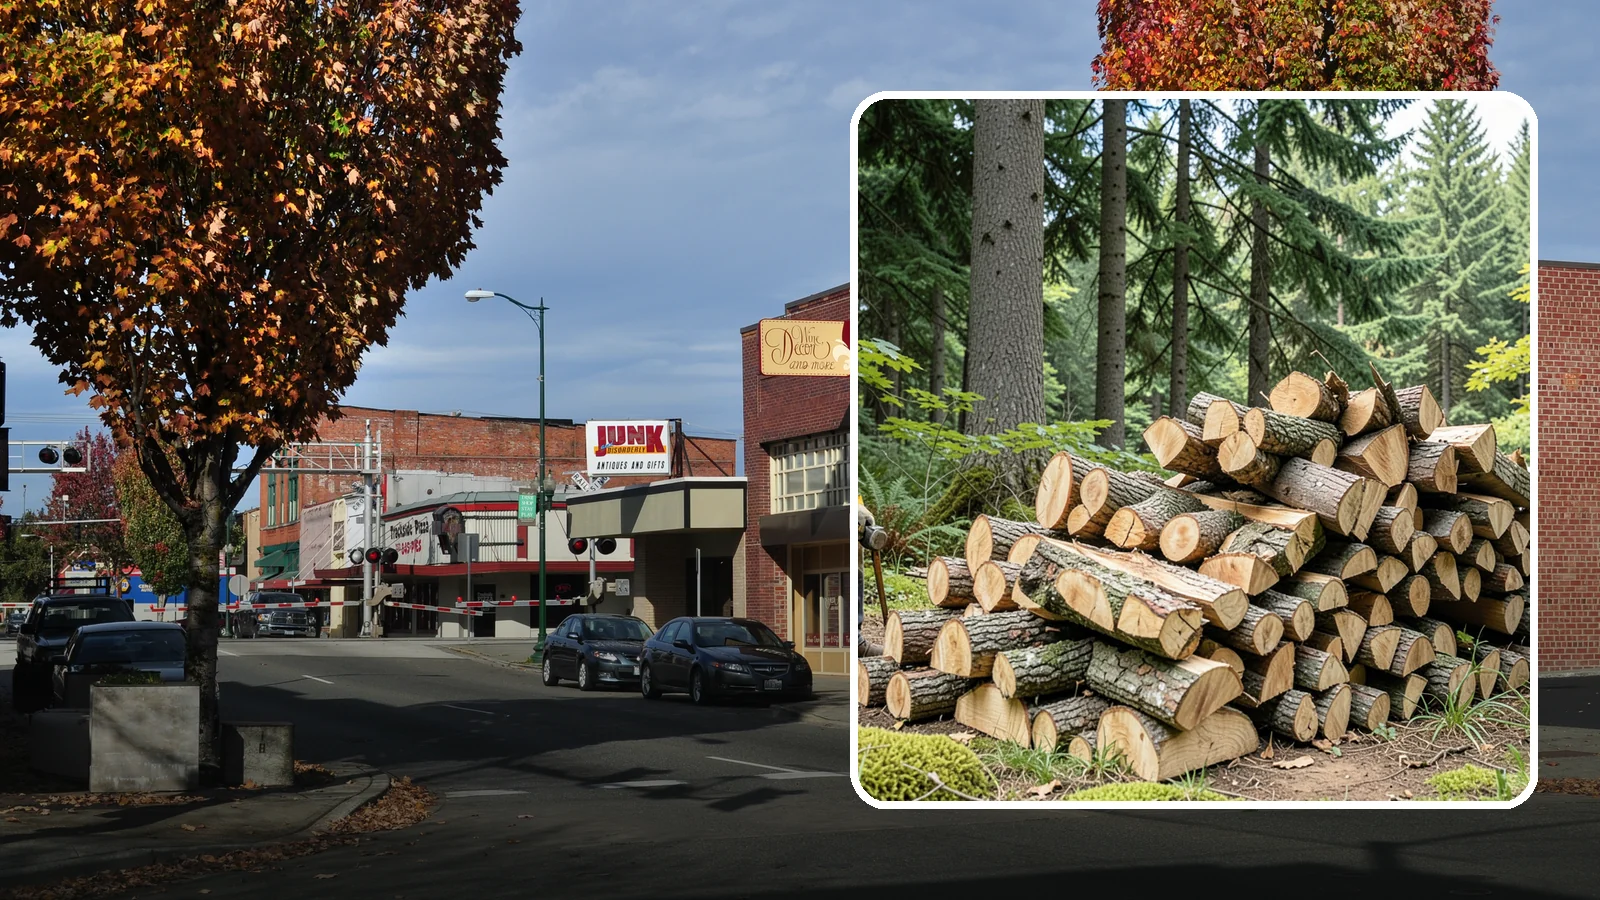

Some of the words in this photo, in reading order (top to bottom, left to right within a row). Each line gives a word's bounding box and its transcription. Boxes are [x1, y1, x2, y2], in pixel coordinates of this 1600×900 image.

[765, 328, 831, 365] Decor
[595, 425, 665, 457] JUNK
[607, 446, 646, 454] DISORDERLY
[597, 461, 628, 470] ANTIQUES
[631, 461, 644, 470] AND
[647, 460, 665, 470] GIFTS
[390, 522, 413, 540] Trackside
[414, 519, 429, 535] Pizza
